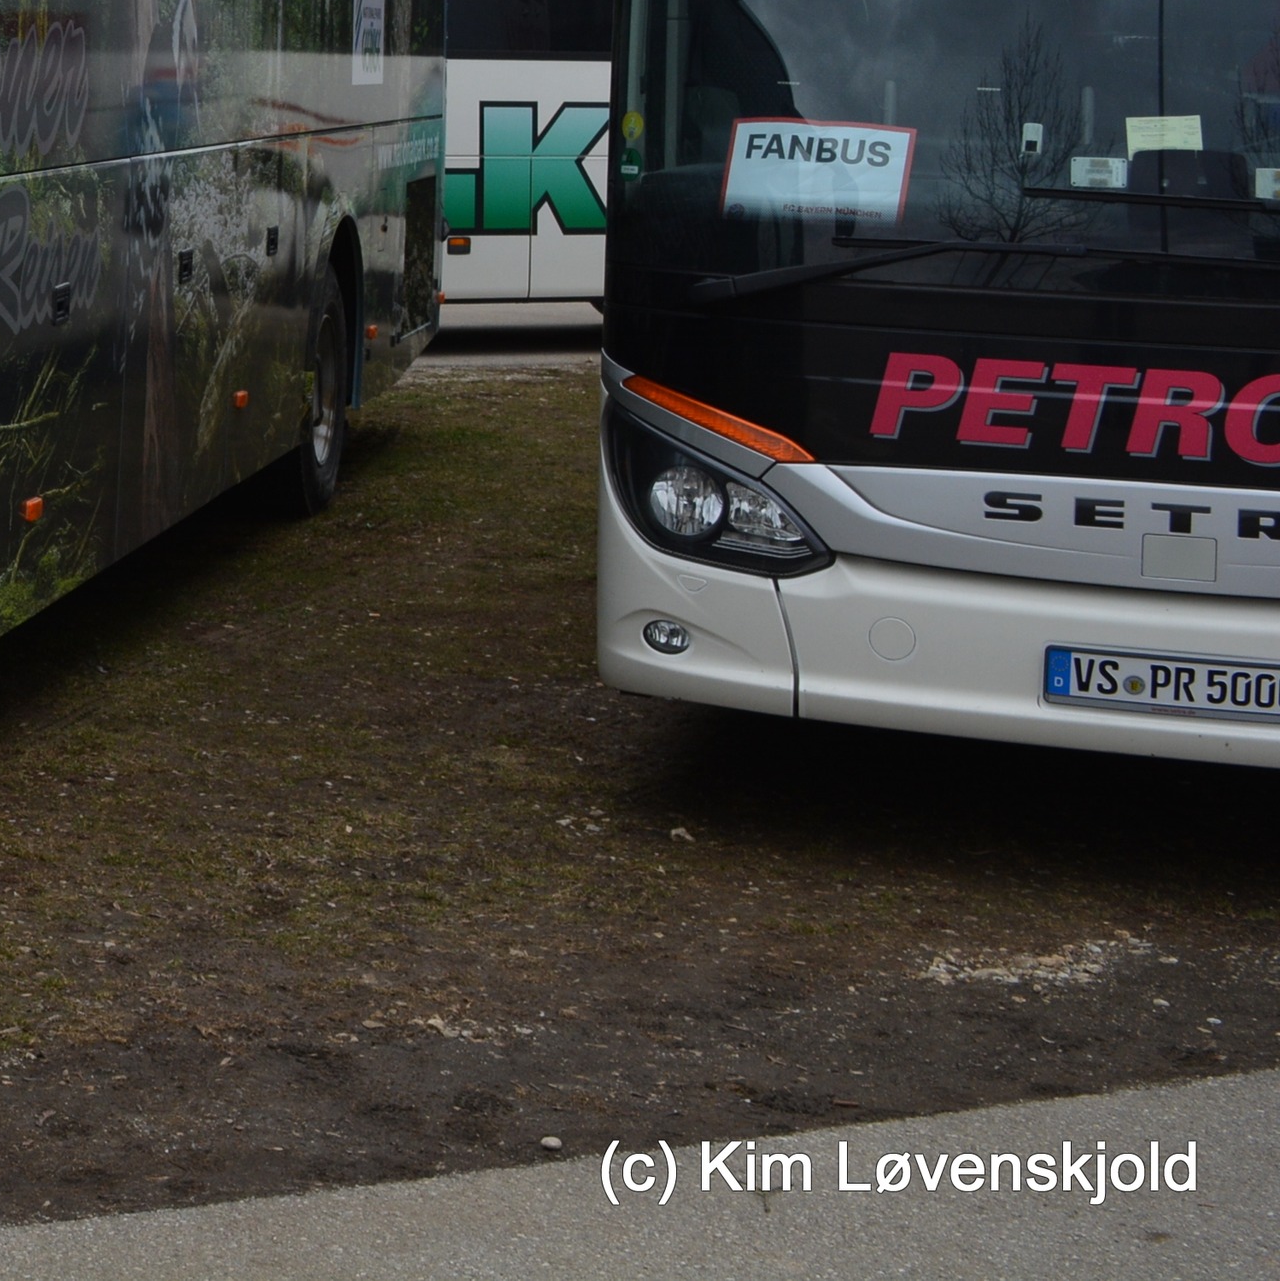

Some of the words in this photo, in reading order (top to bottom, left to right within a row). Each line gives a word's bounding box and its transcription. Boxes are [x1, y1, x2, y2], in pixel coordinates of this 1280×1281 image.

[745, 133, 892, 167] FANBUS
[783, 204, 795, 212] FC
[797, 205, 833, 214] BAYERN
[835, 207, 882, 218] MÜNCHEN
[983, 490, 1280, 540] SETR
[1054, 677, 1064, 687] D
[1073, 657, 1120, 695] VS
[1150, 664, 1195, 702] PR
[1206, 669, 1280, 708] 500
